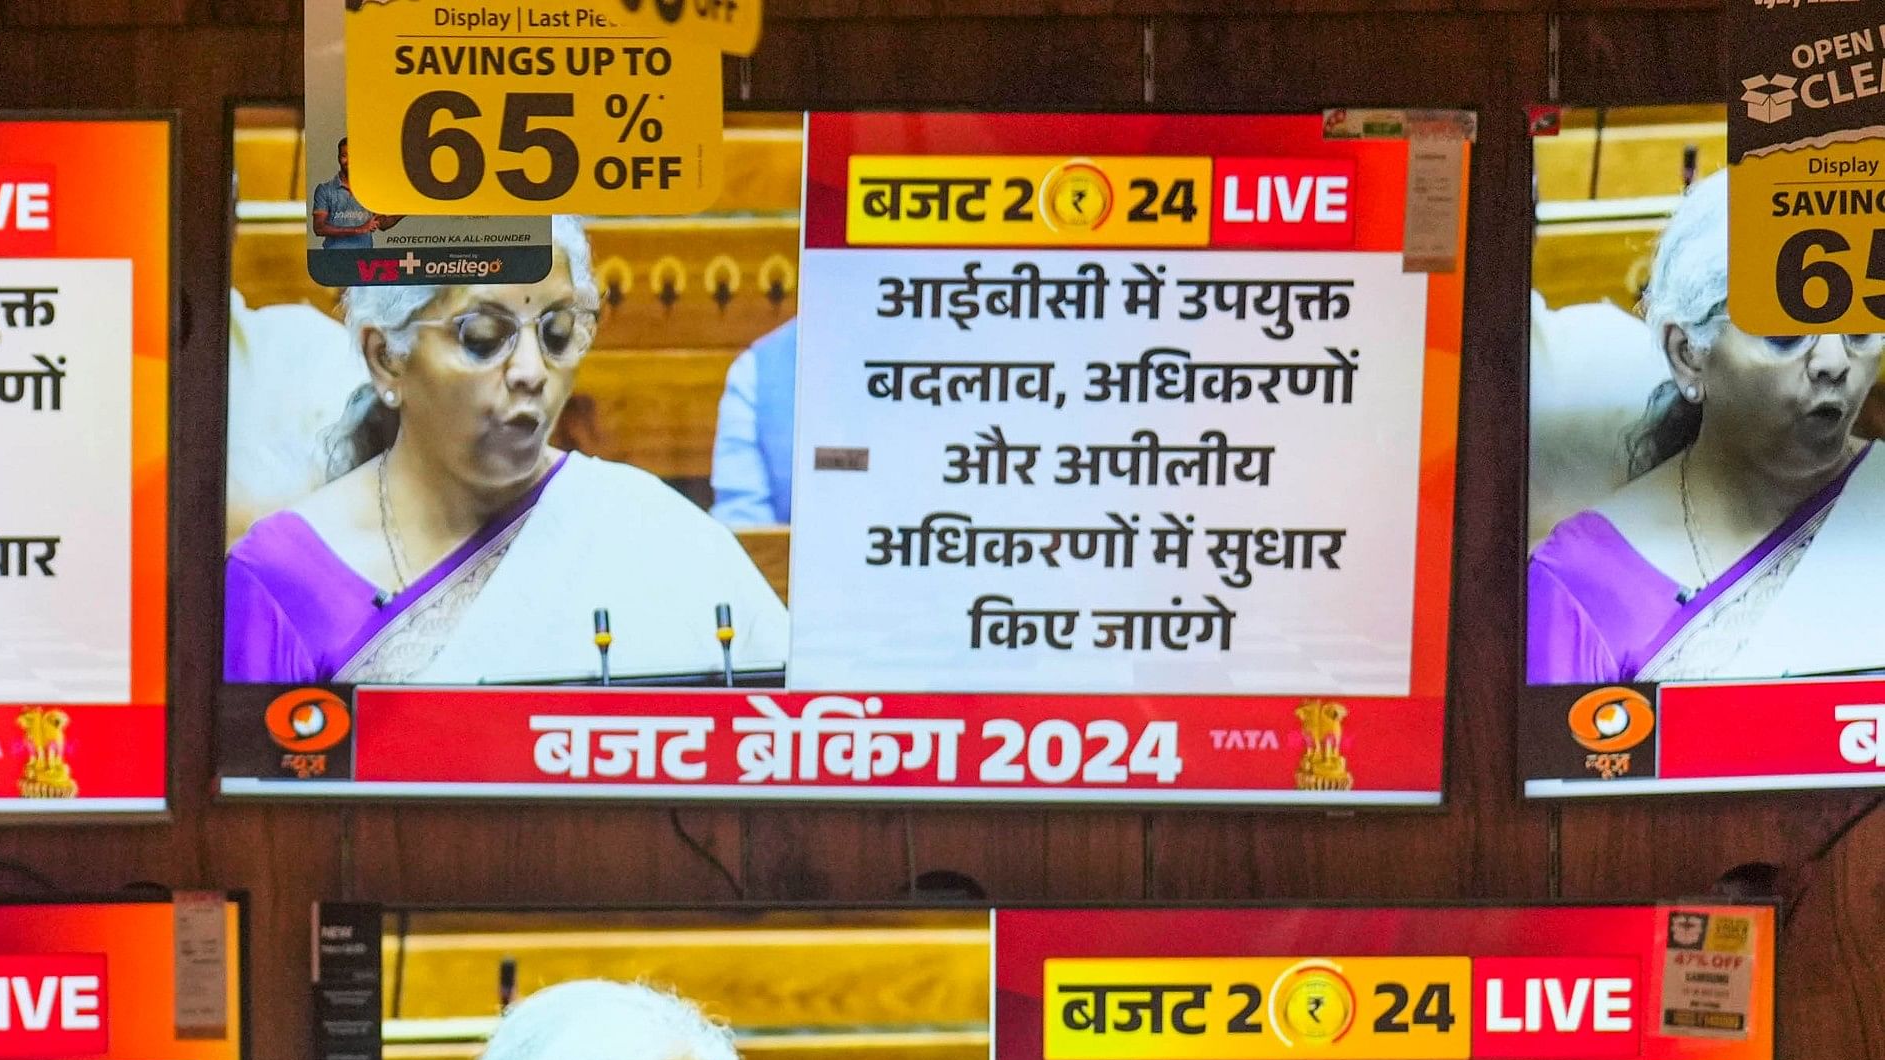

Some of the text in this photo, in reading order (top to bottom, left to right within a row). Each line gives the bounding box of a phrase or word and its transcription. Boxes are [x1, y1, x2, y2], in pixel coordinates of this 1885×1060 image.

[434, 7, 511, 32] Display
[528, 8, 570, 28] Last
[395, 45, 672, 77] SAVINGS UP TO
[1792, 29, 1874, 69] OPEN
[400, 90, 580, 202] 65
[1809, 157, 1878, 177] Display
[594, 156, 682, 190] OFF
[859, 177, 992, 223] बजट
[1223, 175, 1348, 223] LIVE
[387, 236, 443, 244] PROTECTION
[463, 234, 531, 242] ALL-ROUNDER
[425, 259, 502, 276] onsitego
[877, 261, 1355, 341] आईबीसी में उपयुक्त
[864, 347, 1360, 410] बदलाव, अधिकरणों
[943, 425, 1276, 487] और अपीलीय
[866, 511, 1347, 589] अधिकरणों में सुधार
[967, 594, 1237, 651] किए जाएंगे
[529, 694, 1183, 784] बजट ब्रेकिंग 2024
[1210, 729, 1279, 750] TATA
[1057, 983, 1213, 1036] बजट
[1486, 977, 1632, 1032] LIVE
